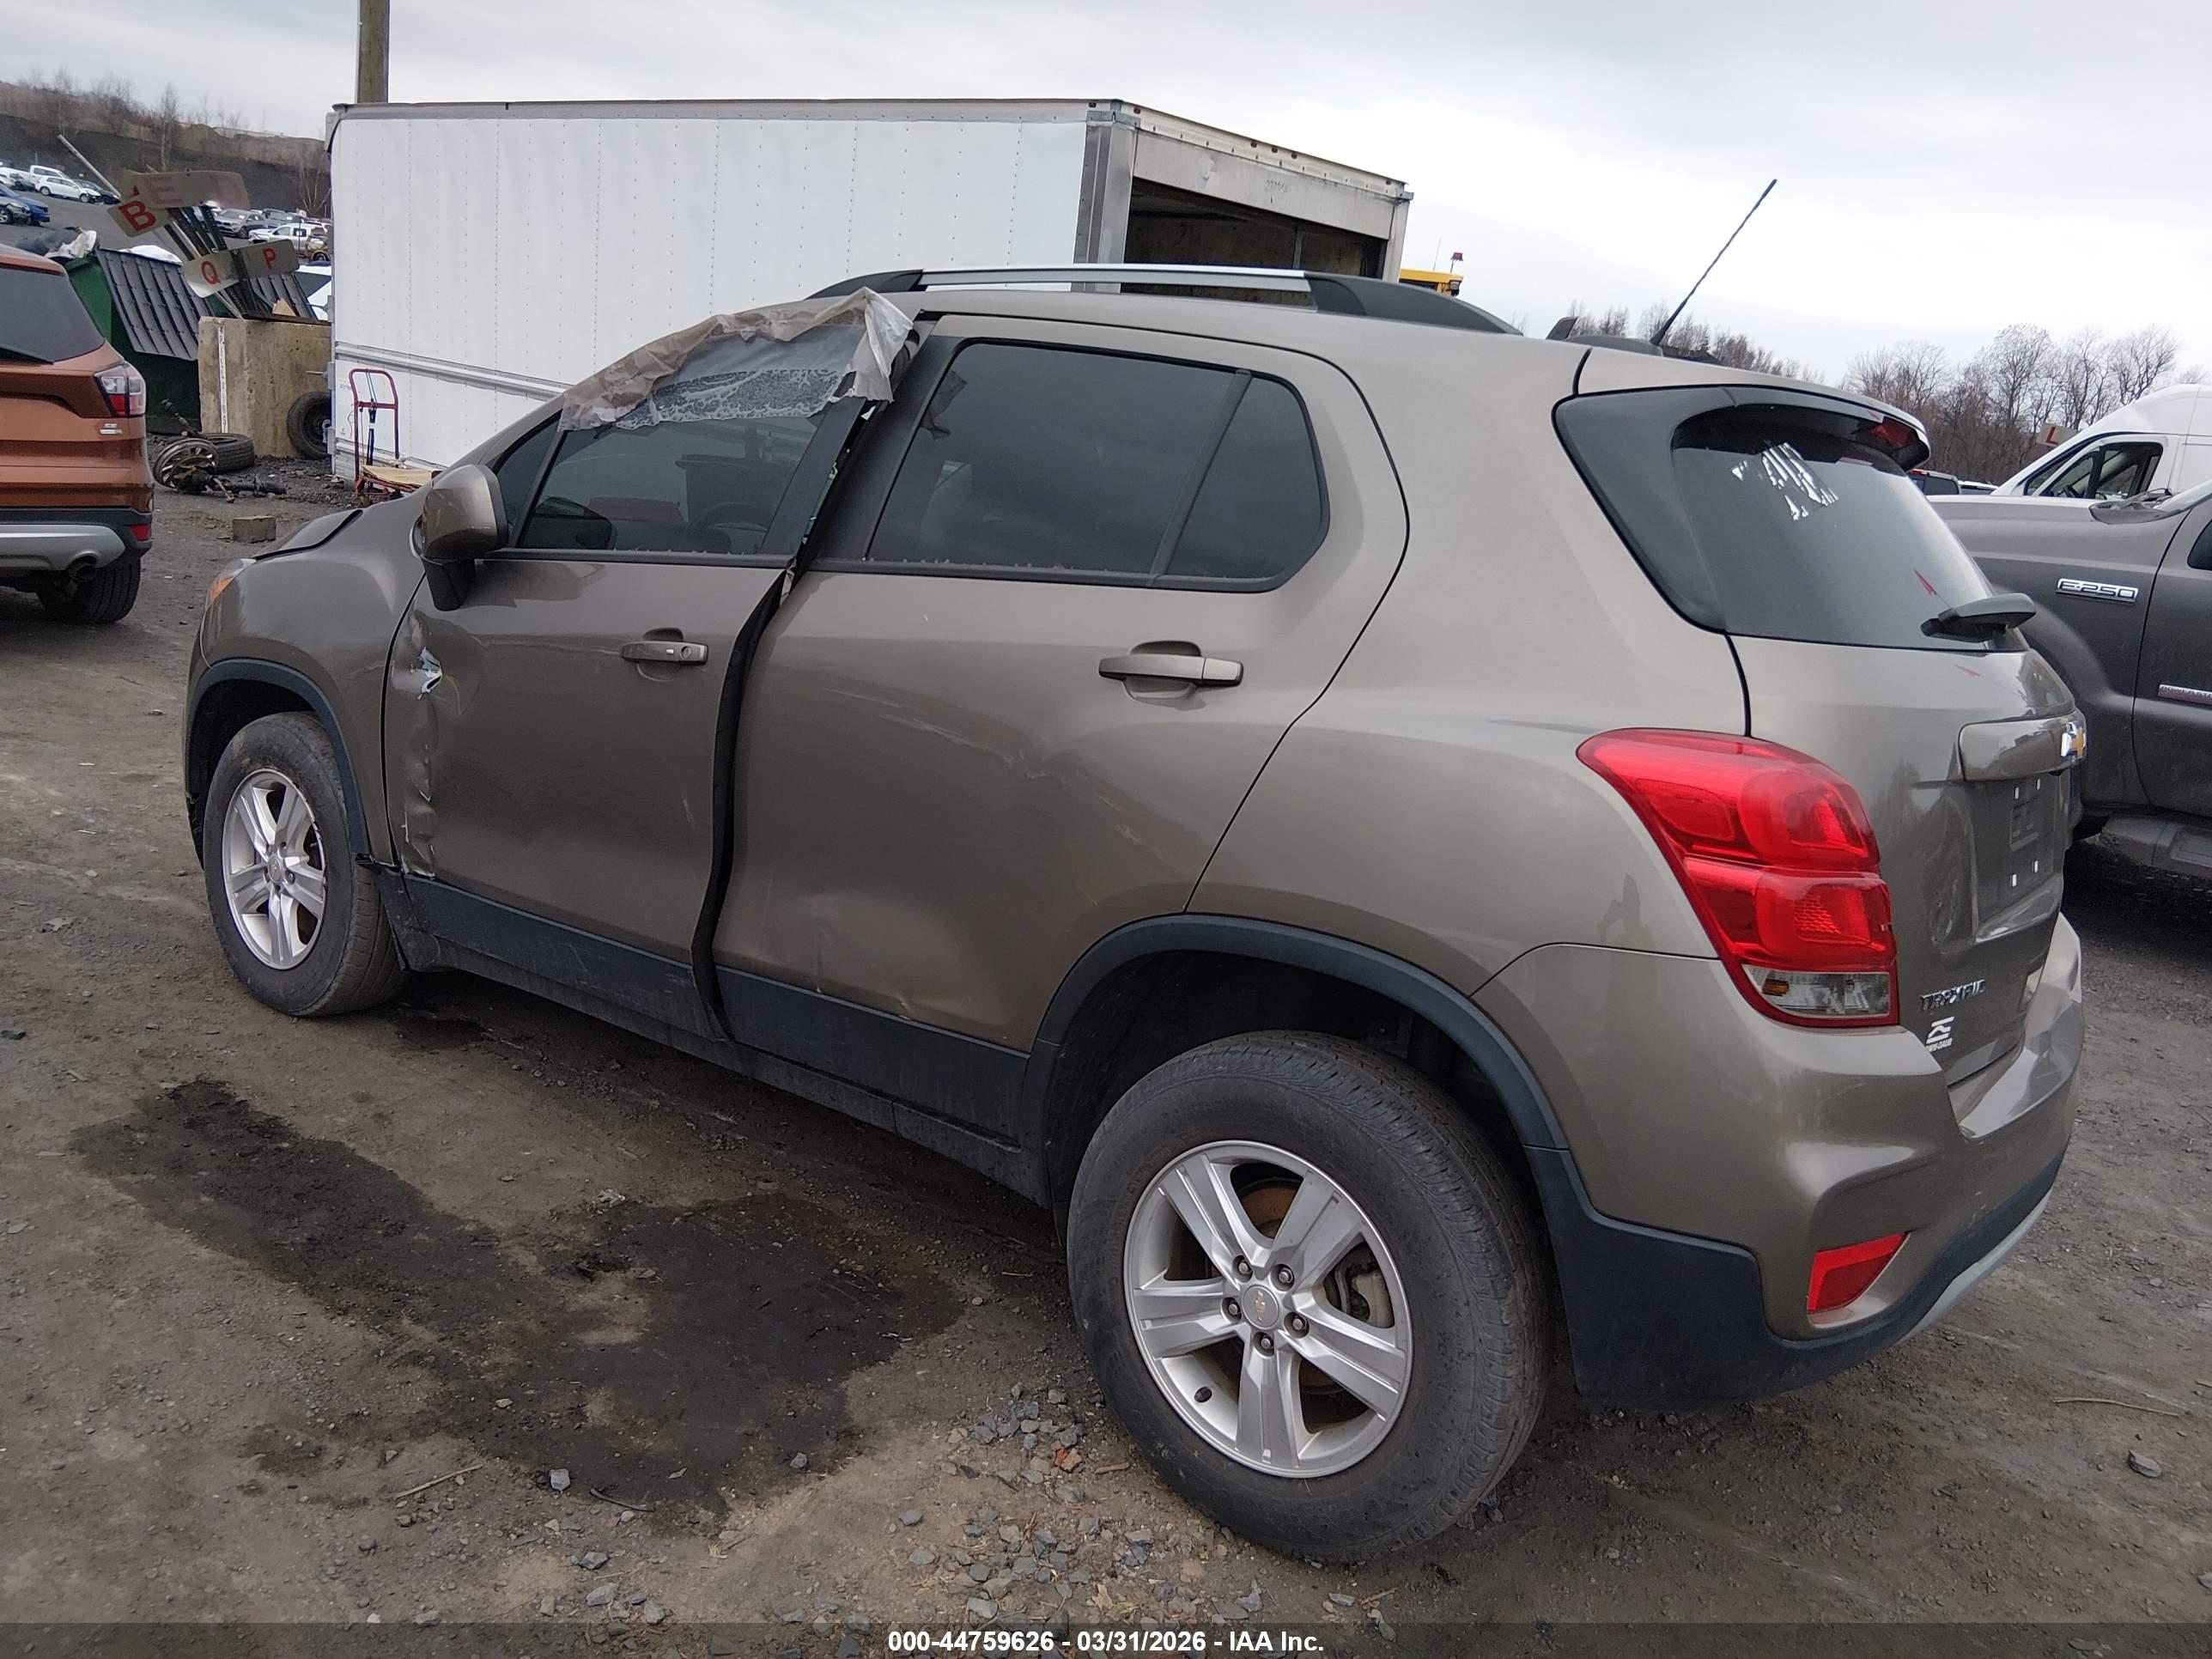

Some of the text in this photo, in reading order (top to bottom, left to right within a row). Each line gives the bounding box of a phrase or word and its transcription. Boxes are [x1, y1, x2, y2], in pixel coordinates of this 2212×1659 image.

[118, 200, 156, 233] B
[263, 247, 277, 270] P
[201, 260, 221, 284] Q
[2046, 426, 2059, 446] L
